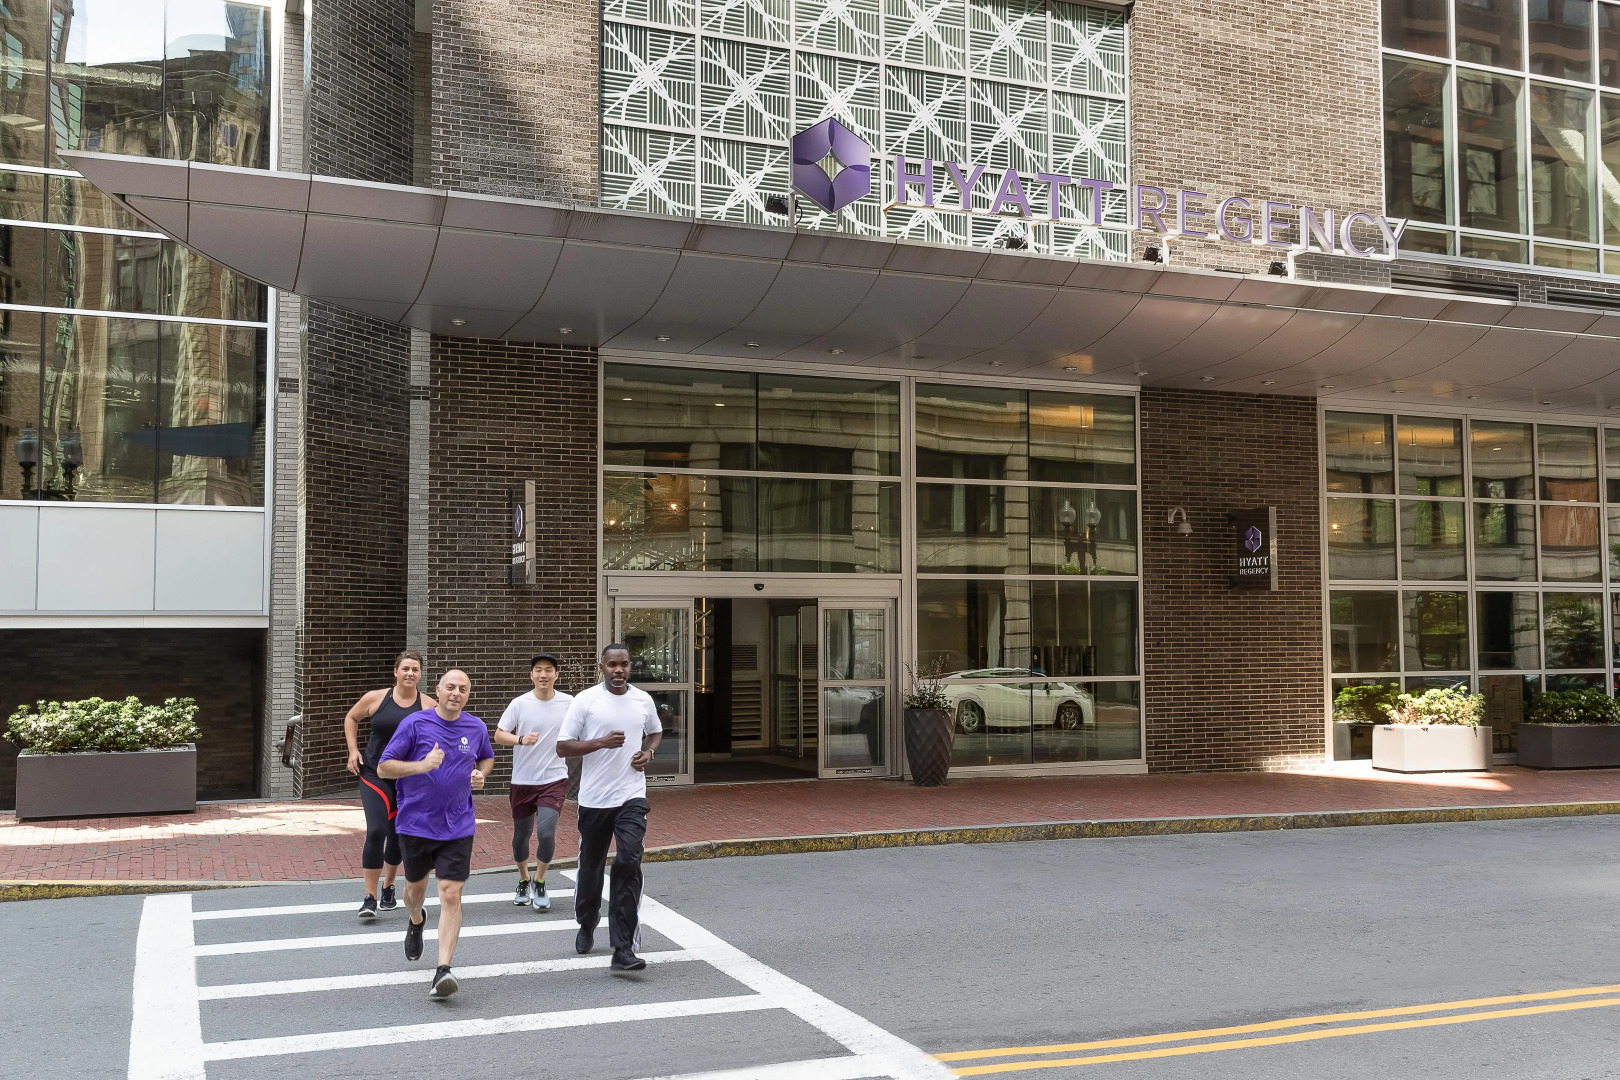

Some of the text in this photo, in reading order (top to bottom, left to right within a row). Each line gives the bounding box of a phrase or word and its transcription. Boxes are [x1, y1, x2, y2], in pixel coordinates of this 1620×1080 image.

[894, 155, 1409, 260] HYATT REGENCY
[1239, 556, 1268, 567] HYATT
[1239, 567, 1268, 575] REGENCY
